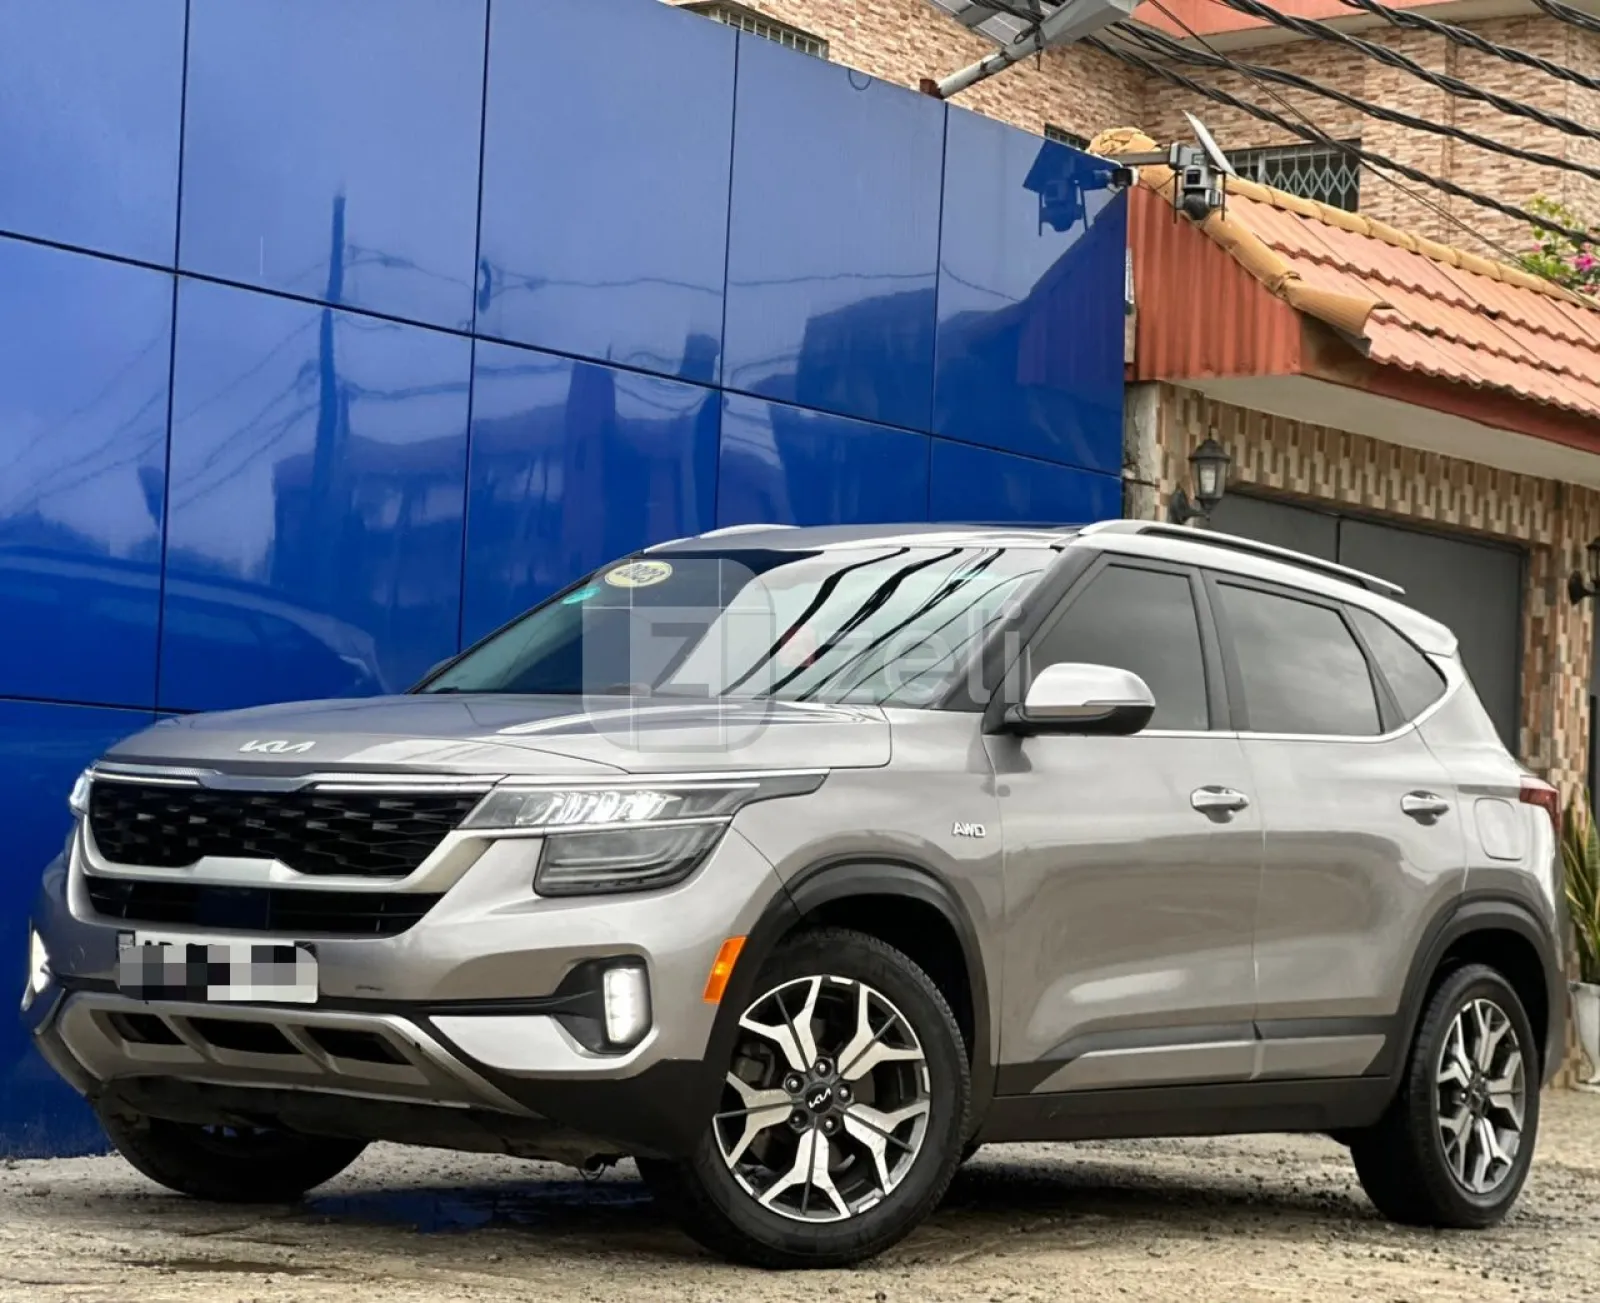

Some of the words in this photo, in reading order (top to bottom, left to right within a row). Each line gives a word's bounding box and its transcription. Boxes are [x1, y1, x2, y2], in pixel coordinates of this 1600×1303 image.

[239, 739, 316, 754] KIA
[952, 821, 986, 838] AWD
[808, 1087, 832, 1108] KIA
